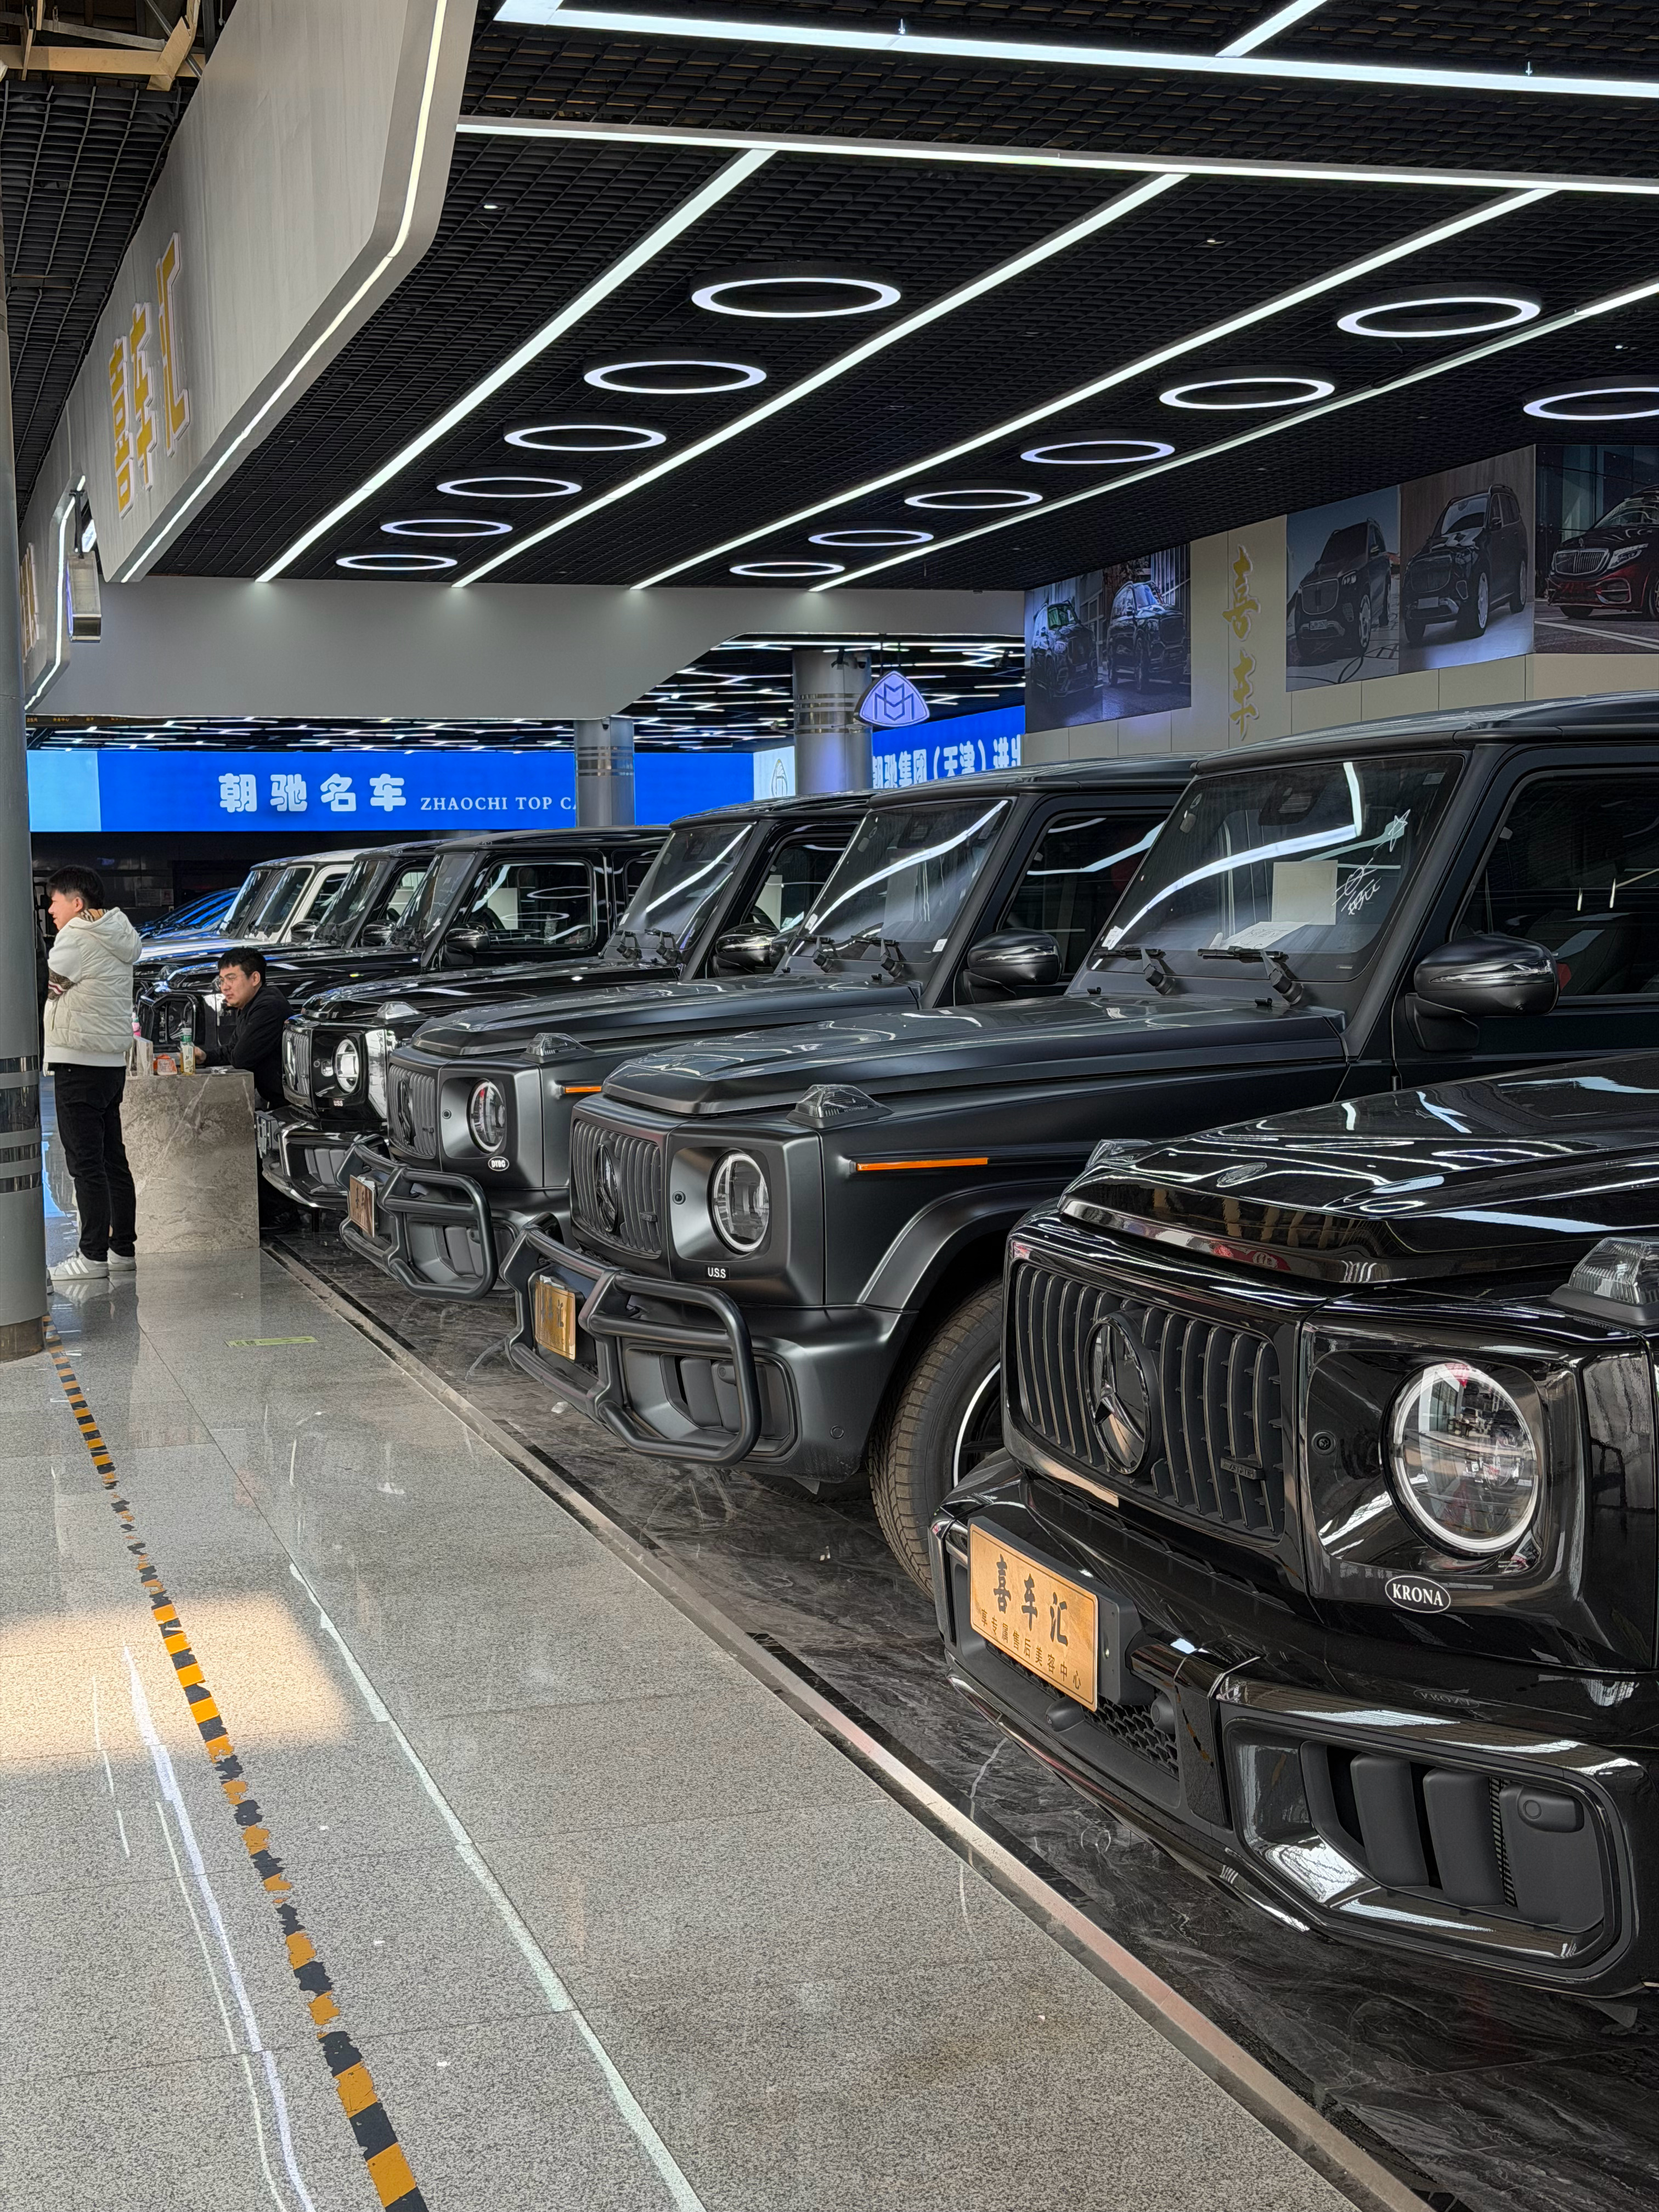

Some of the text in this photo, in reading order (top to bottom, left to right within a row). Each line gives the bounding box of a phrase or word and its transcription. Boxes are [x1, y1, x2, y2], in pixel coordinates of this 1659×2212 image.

[218, 773, 407, 813] 朝驰名车
[420, 797, 576, 810] ZHAOCHI TOP C
[993, 1554, 1069, 1647] 喜车汇
[1392, 1583, 1444, 1606] KRONA
